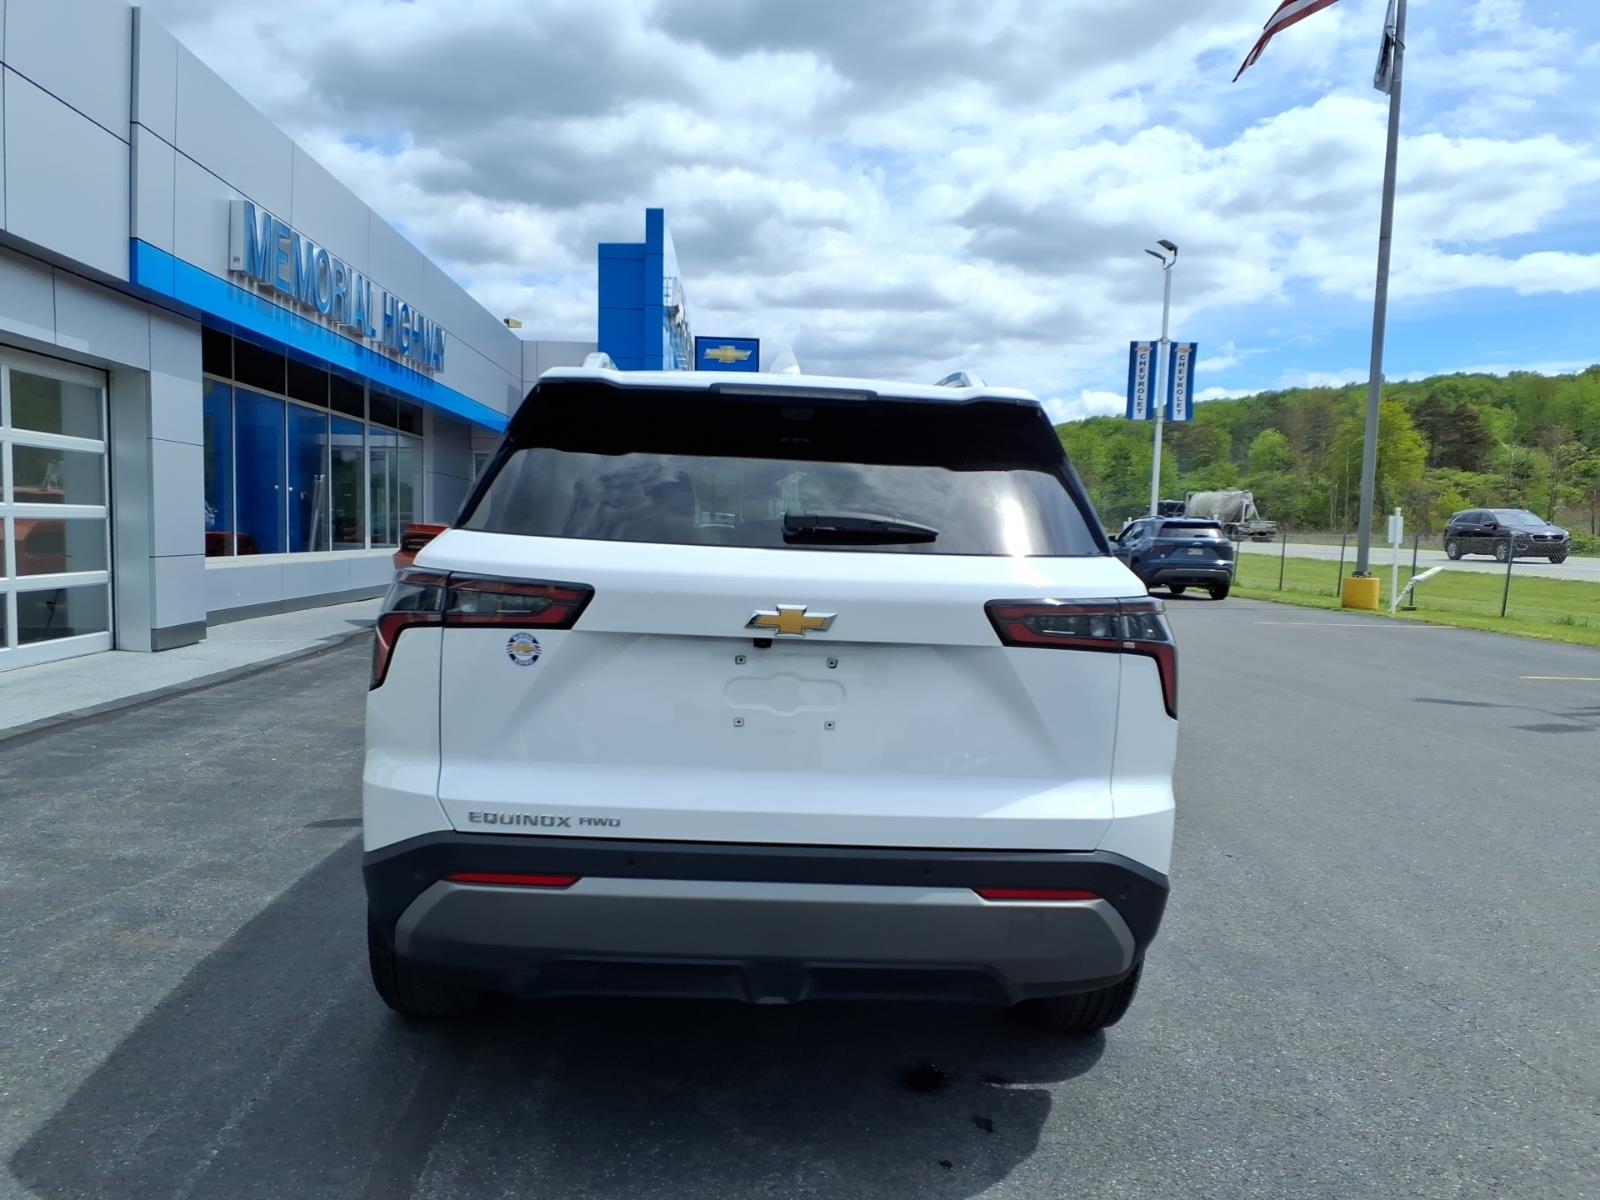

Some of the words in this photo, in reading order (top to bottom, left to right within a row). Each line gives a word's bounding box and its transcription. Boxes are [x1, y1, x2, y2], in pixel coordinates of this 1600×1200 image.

[242, 200, 376, 338] MEMORIAL
[382, 290, 447, 373] HIGHWAY
[1136, 353, 1147, 414] CHEVROLET
[1176, 354, 1186, 415] CHEVROLET
[468, 811, 571, 828] EQUINOX
[578, 816, 621, 828] AWD
